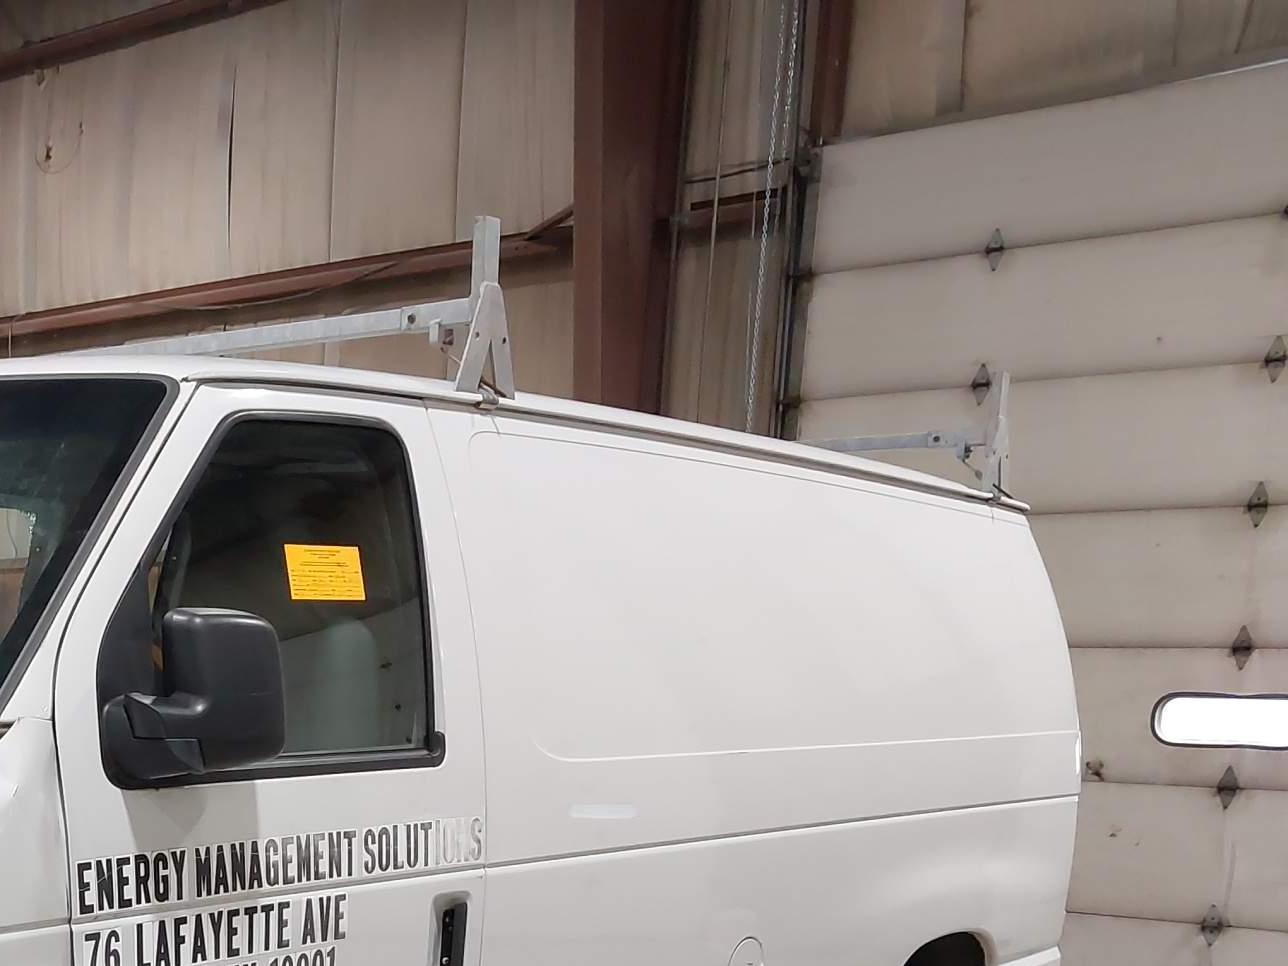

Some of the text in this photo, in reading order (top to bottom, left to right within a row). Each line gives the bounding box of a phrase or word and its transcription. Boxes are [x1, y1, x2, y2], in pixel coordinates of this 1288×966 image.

[77, 850, 186, 915] ENERGY
[195, 831, 357, 897] MANAGEMENT
[302, 894, 347, 943] AVE
